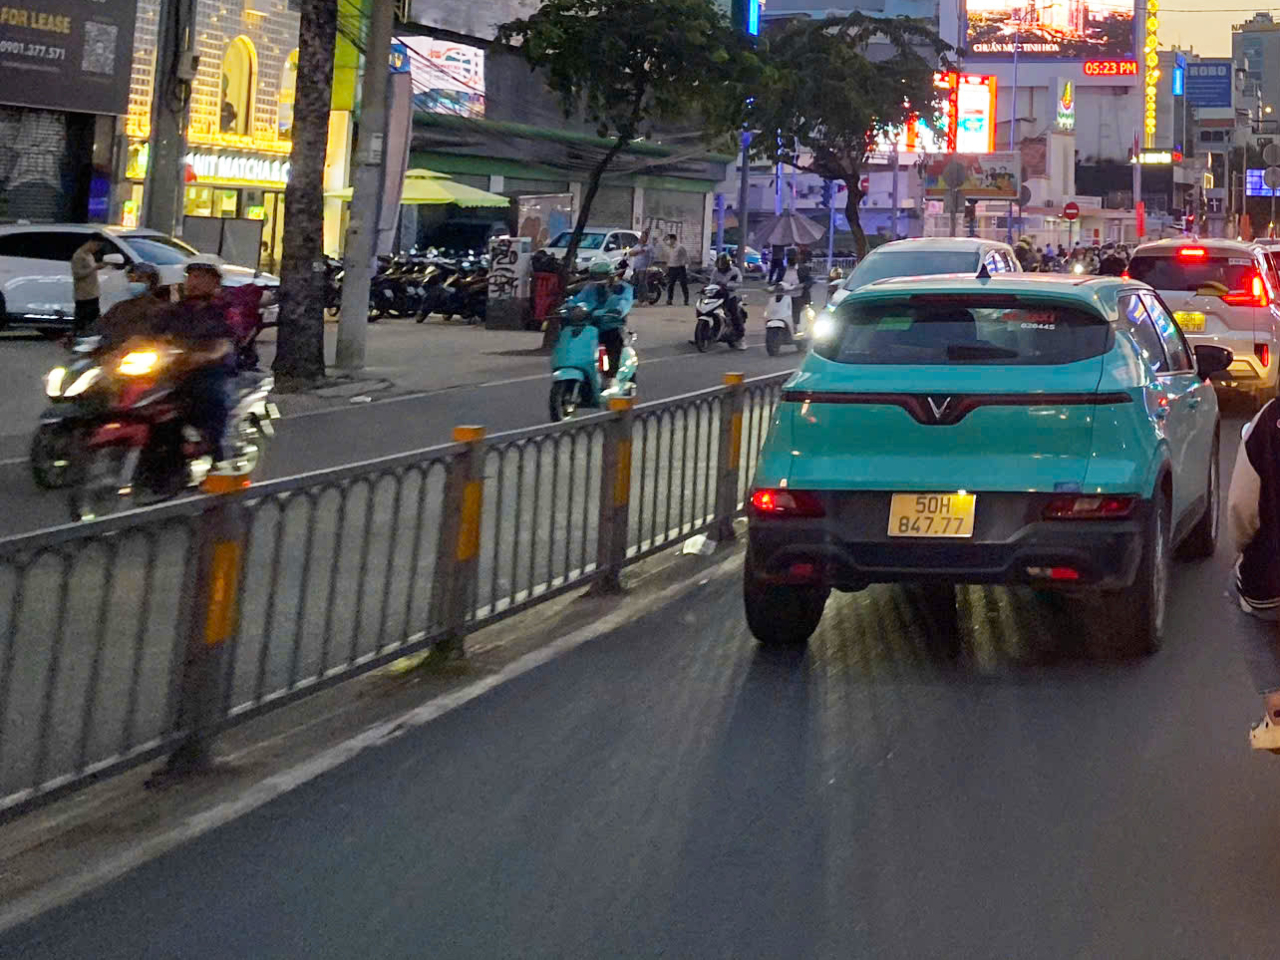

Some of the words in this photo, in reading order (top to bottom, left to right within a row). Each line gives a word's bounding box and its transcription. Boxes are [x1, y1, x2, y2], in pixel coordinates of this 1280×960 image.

[0, 6, 28, 28] FOR
[31, 12, 71, 34] LEASE
[1085, 62, 1117, 74] 05:23
[1120, 62, 1137, 74] PM
[218, 155, 270, 180] MATCHA
[915, 497, 950, 514] 50H
[899, 516, 964, 534] 847.77
